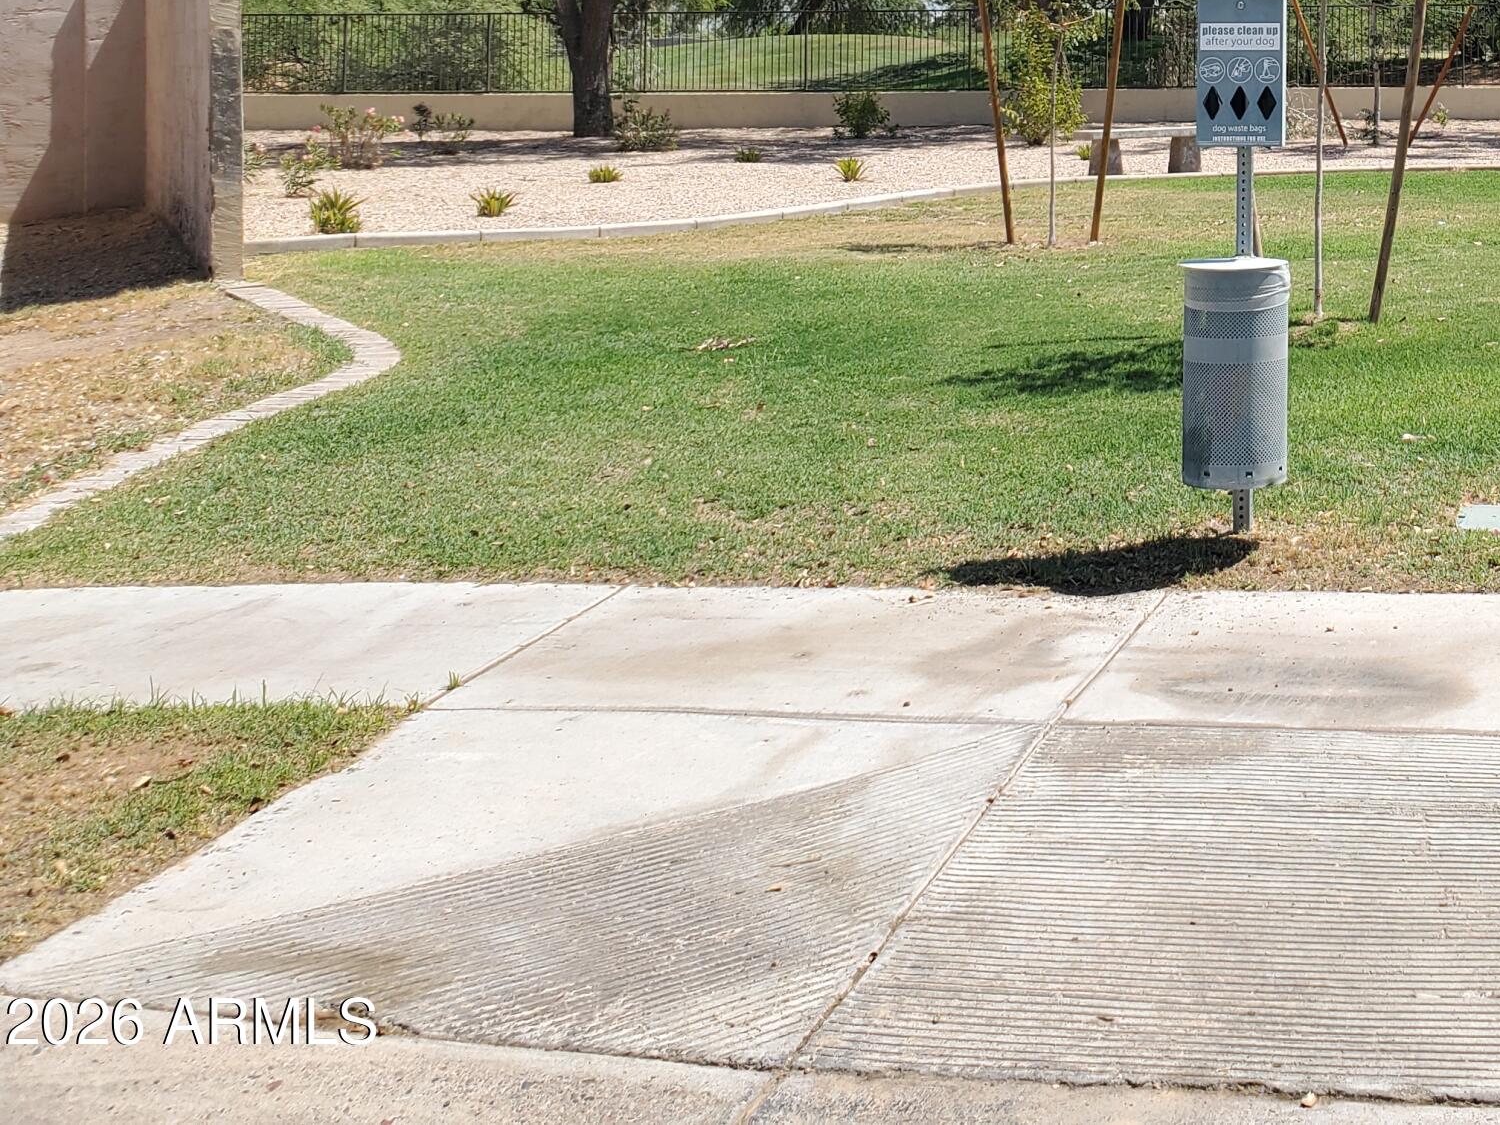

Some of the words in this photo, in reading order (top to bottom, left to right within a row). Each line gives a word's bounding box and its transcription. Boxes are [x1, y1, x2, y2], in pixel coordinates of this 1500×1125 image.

[1202, 26, 1234, 36] please
[1237, 26, 1263, 35] clean
[1266, 27, 1278, 36] up
[1205, 36, 1229, 46] after
[1231, 38, 1253, 47] your
[1255, 36, 1275, 47] dog
[1212, 124, 1226, 133] dog
[1249, 124, 1266, 133] bags
